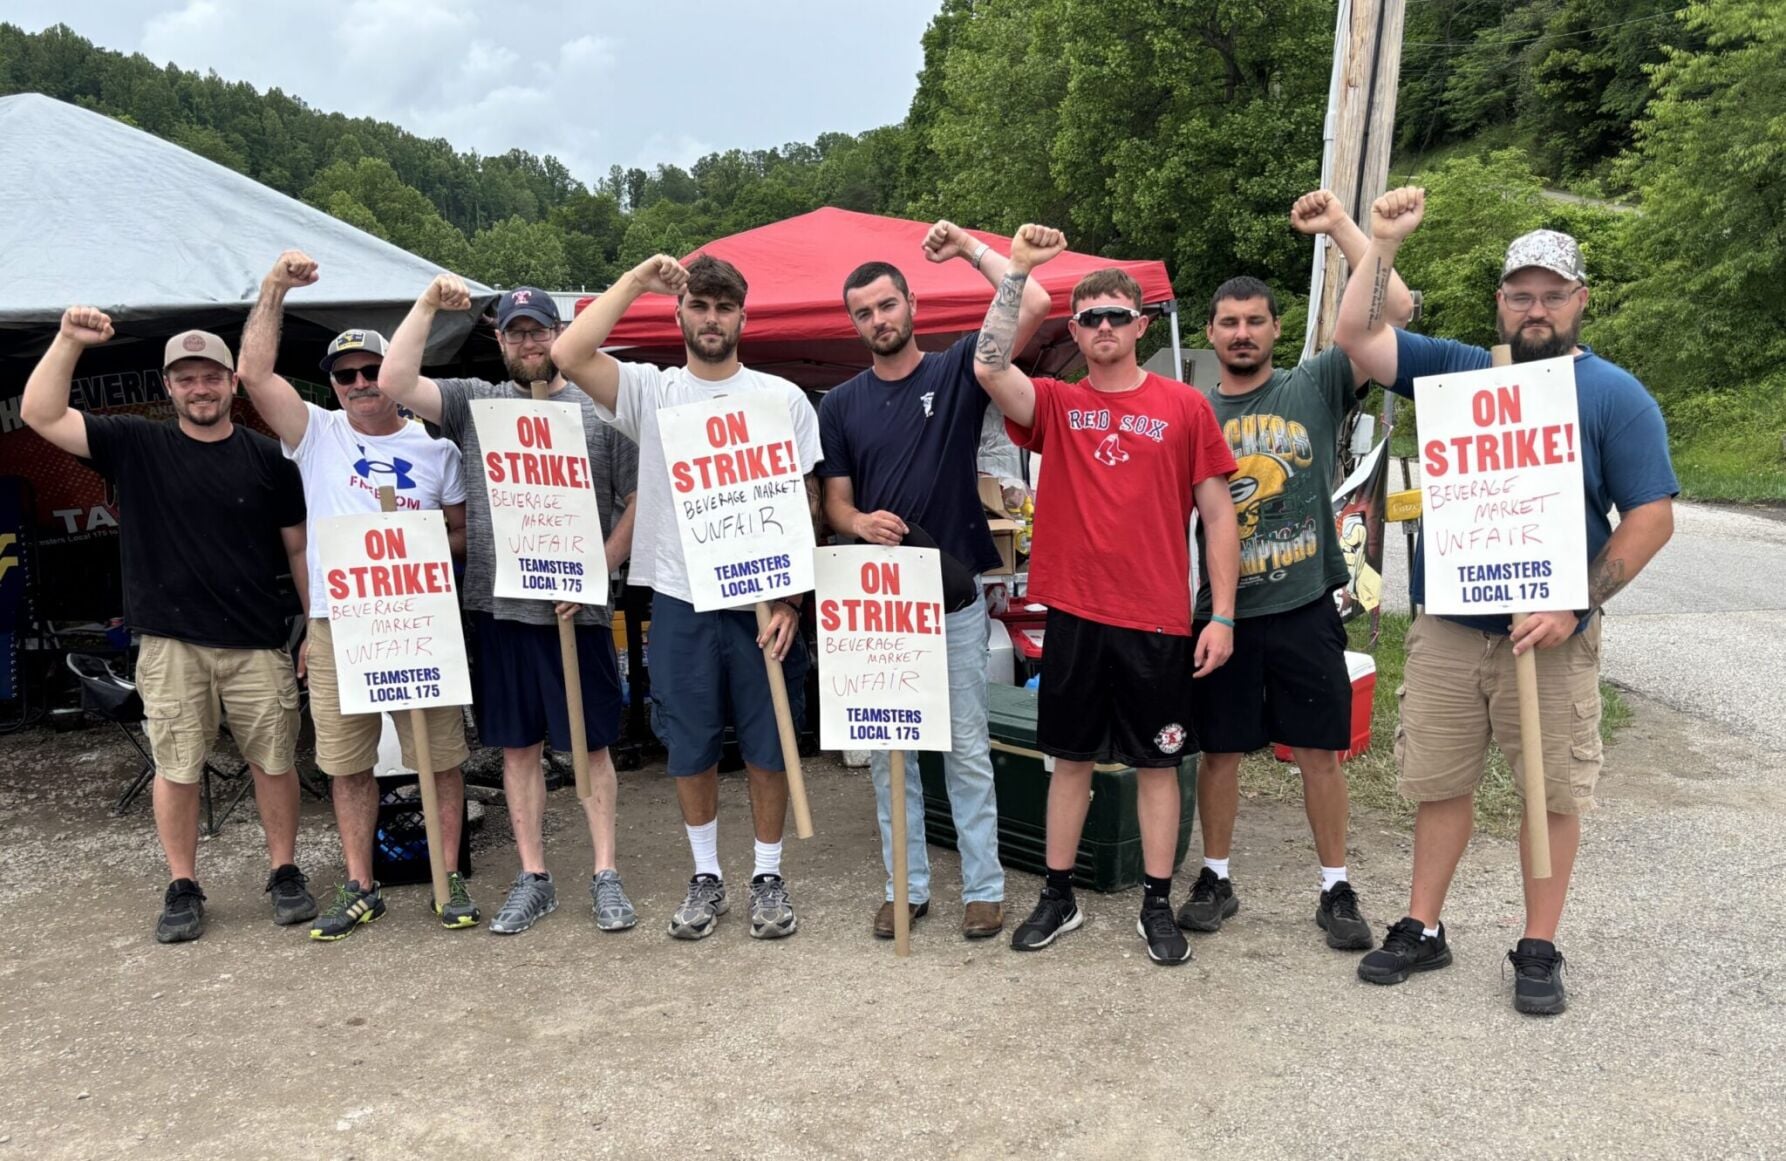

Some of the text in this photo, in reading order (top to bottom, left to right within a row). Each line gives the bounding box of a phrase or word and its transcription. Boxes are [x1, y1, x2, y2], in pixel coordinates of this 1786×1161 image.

[1472, 385, 1521, 427] ON
[517, 416, 552, 449] ON
[706, 411, 749, 448] ON
[1068, 408, 1169, 442] RED SOX
[1223, 414, 1313, 468] CKERS
[1425, 422, 1575, 477] STRIKE!
[485, 451, 592, 490] STRIKE!
[672, 439, 797, 494] STRIKE!
[349, 475, 420, 511] FEOM
[491, 488, 562, 510] BEVERAGE
[683, 478, 800, 521] BEVERAGE MARKET
[1427, 474, 1520, 514] BEVERAGE
[1473, 491, 1560, 523] MARKET
[522, 513, 579, 528] MARKET
[691, 505, 784, 544] UNFAIR
[365, 528, 407, 560] ON
[508, 535, 584, 554] UNFAIR
[1436, 524, 1543, 556] UNFAIR
[328, 562, 451, 600] STRIKE!
[518, 558, 583, 577] TEAMSTERS
[714, 554, 791, 582] TEAMSTERS
[861, 562, 900, 595] ON
[1457, 560, 1552, 584] TEAMSTERS
[523, 575, 582, 592] LOCAL 175
[720, 572, 791, 598] LOCAL 175
[1462, 582, 1549, 603] LOCAL 175
[332, 599, 416, 621] BEVERAGE
[821, 599, 941, 635] STRIKE!
[372, 615, 435, 634] MARKET
[346, 636, 432, 664] UNFAIR
[826, 637, 906, 654] BEVERAGE
[867, 649, 932, 664] MARKET
[364, 667, 440, 688] TEAMSTERS
[832, 671, 920, 697] UNFAIR
[370, 684, 440, 702] LOCAL 175
[846, 708, 922, 723] TEAMSTERS
[850, 725, 920, 740] LOCAL 175
